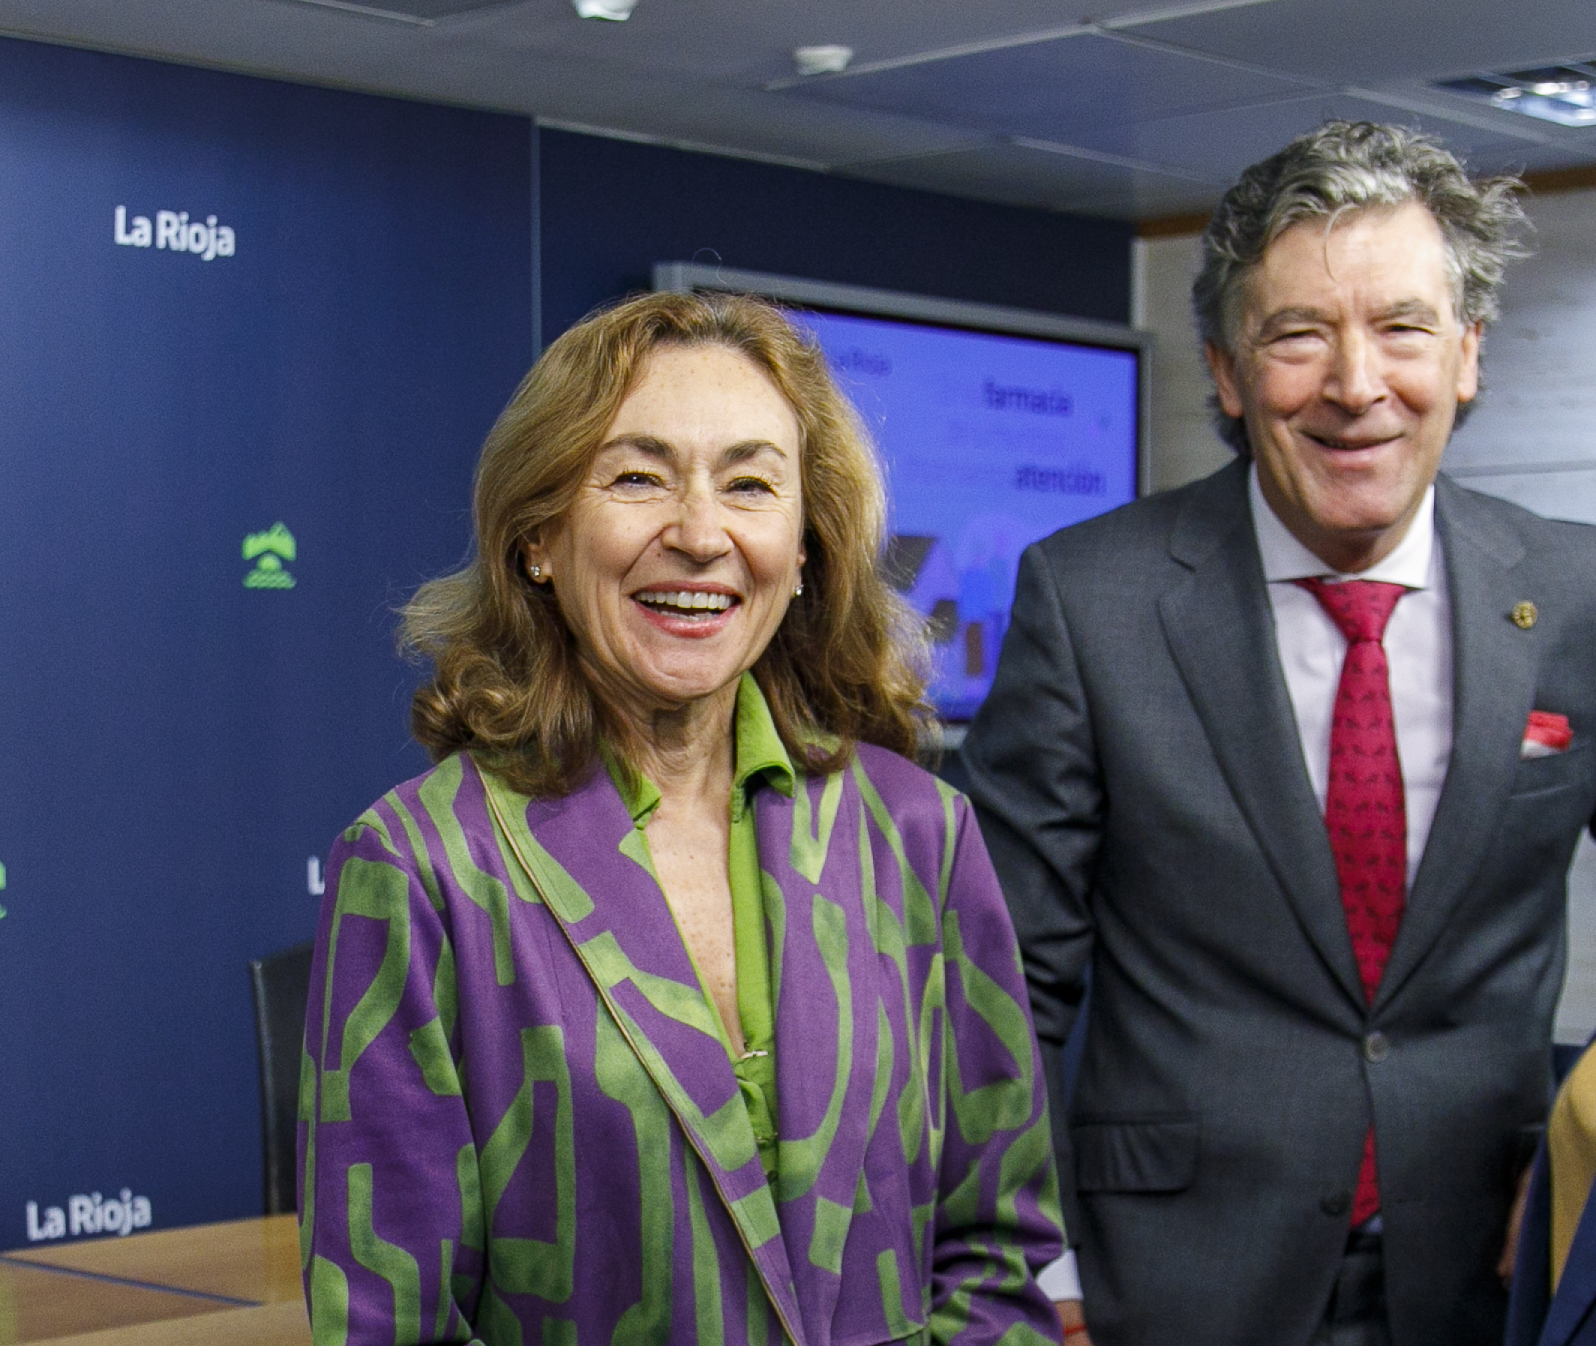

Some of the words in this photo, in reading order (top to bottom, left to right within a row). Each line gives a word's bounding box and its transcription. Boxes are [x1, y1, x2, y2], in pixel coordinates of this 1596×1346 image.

[115, 206, 151, 247] La
[157, 211, 234, 260] Rioja
[308, 856, 325, 895] L
[27, 1201, 65, 1242] La
[69, 1188, 152, 1237] Rioja
